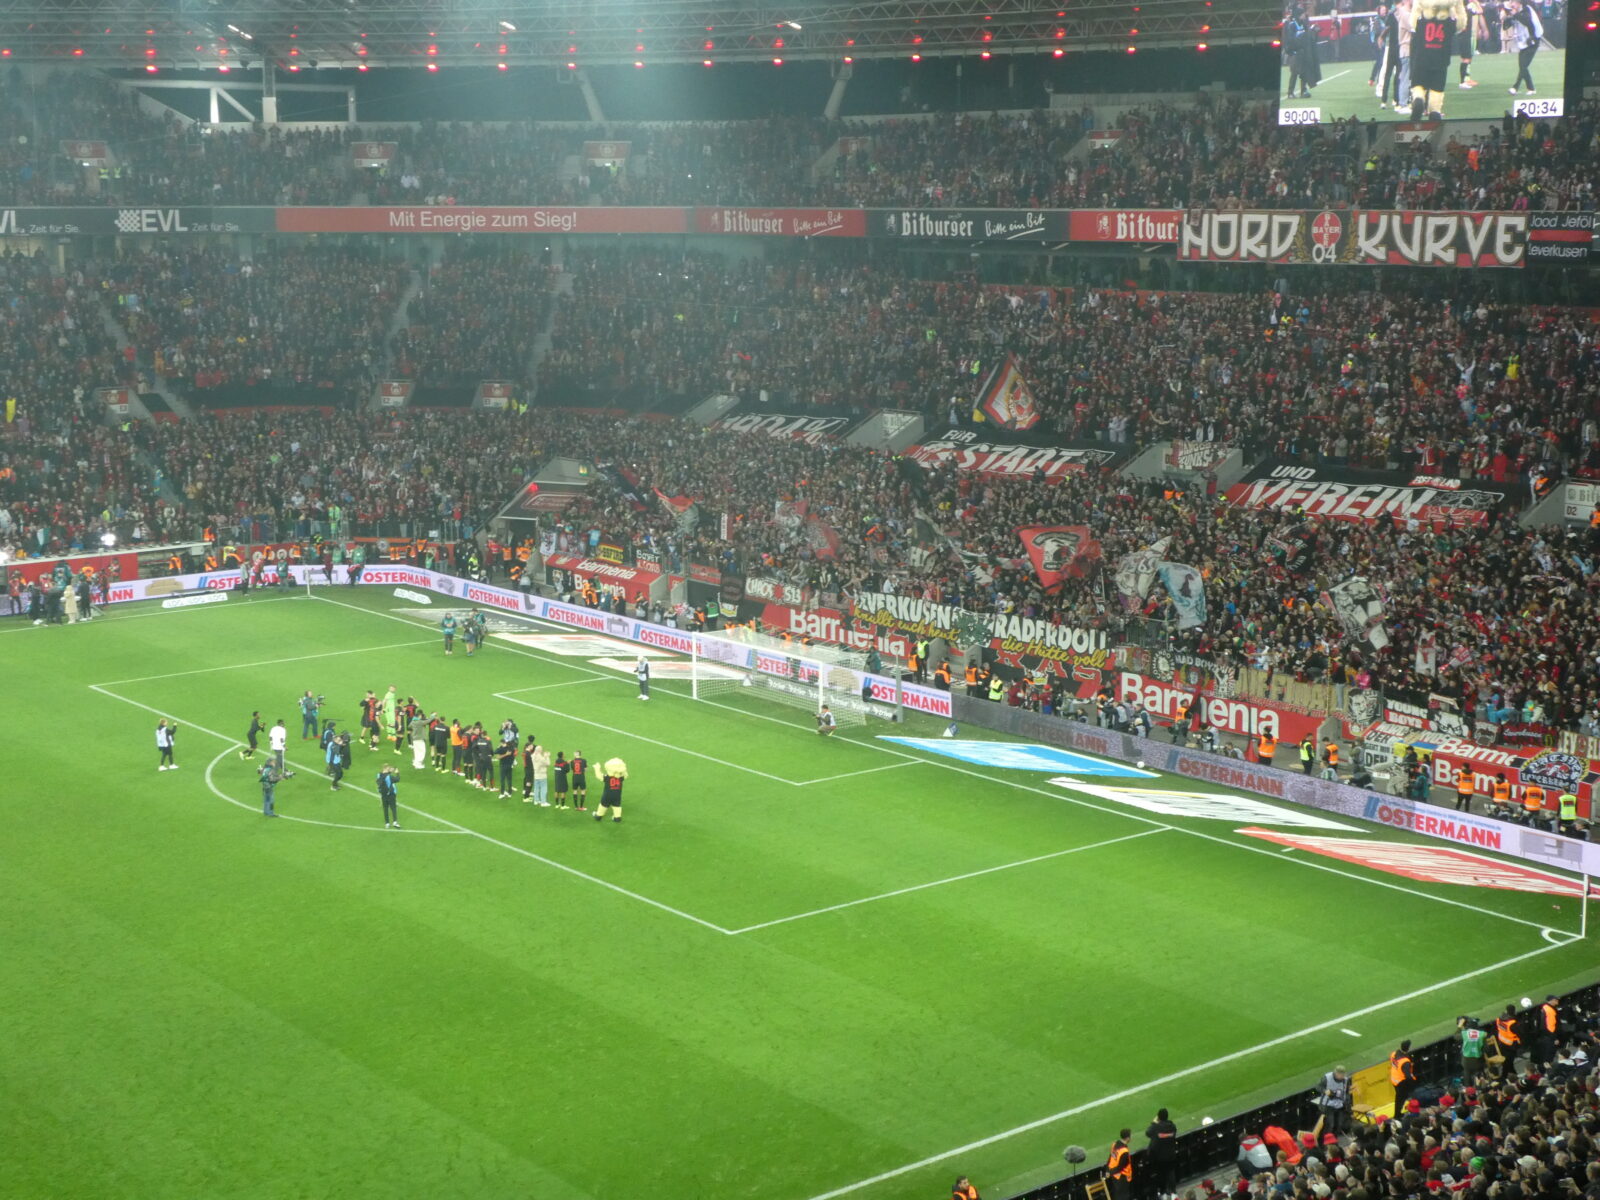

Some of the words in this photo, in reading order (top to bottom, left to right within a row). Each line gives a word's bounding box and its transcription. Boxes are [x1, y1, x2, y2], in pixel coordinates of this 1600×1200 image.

[1284, 111, 1315, 122] 90:00
[1520, 102, 1557, 114] 20:34
[0, 210, 24, 233] VL
[141, 210, 188, 231] EVL
[389, 211, 415, 227] Mit
[420, 211, 486, 231] Energie
[492, 214, 528, 227] zum
[533, 211, 577, 231] Sieg!
[723, 211, 783, 233] Bitburger
[901, 212, 974, 238] Bitburger
[1116, 213, 1178, 240] Bitbur
[1312, 226, 1340, 234] BAYER
[1183, 213, 1300, 258] NORD
[1358, 213, 1526, 264] KURVE
[1312, 243, 1336, 263] 04
[942, 430, 976, 442] FÜR
[959, 444, 1085, 475] STADT
[1270, 465, 1316, 480] UND
[1245, 481, 1437, 517] VEREIN
[364, 572, 431, 588] OSTERMANN
[468, 588, 519, 610] OSTERMANN
[549, 607, 605, 631] OSTERMANN
[640, 629, 702, 655] OSTERMANN
[1436, 735, 1517, 767] Barme
[1178, 757, 1284, 796] OSTERMANN
[1378, 805, 1501, 849] OSTERMANN
